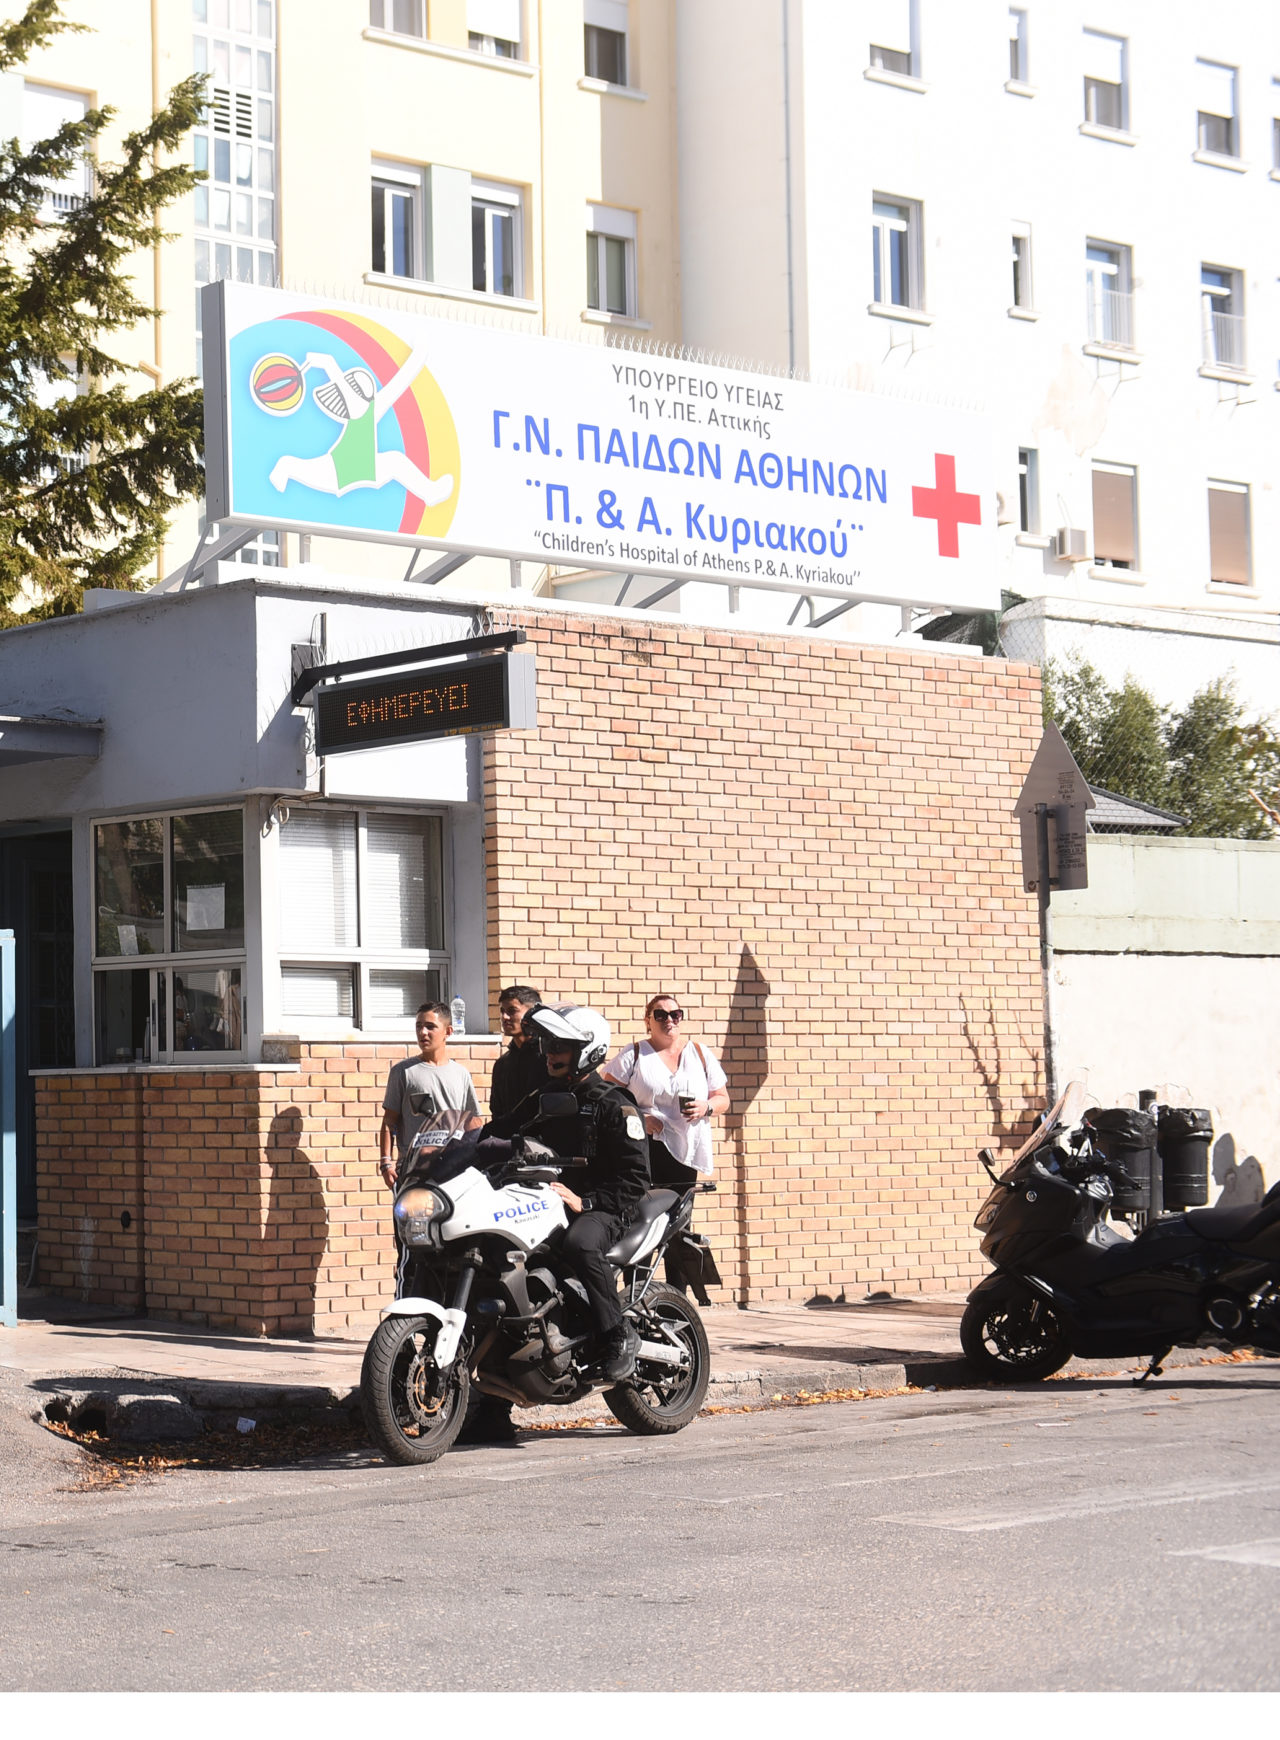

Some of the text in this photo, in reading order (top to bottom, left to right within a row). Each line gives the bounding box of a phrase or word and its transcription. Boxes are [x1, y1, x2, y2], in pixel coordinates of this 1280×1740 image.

[612, 364, 784, 411] ΥΠΟΥΡΓΕΙΟ ΥΓΕΙΑΣ
[629, 394, 771, 440] 1η Υ.ΠΕ. Αττικής
[493, 409, 887, 504] Γ.Ν. ΠΑΙΔΩΝ ΑΘΗΝΩΝ
[596, 489, 625, 531] &
[636, 496, 672, 536] Α.
[620, 542, 679, 564] Hospital
[683, 550, 698, 567] of
[702, 552, 750, 573] Athens
[347, 683, 469, 727] ΕΦΗΜΕΡΕΥΕΙ
[493, 1200, 549, 1222] POLICE
